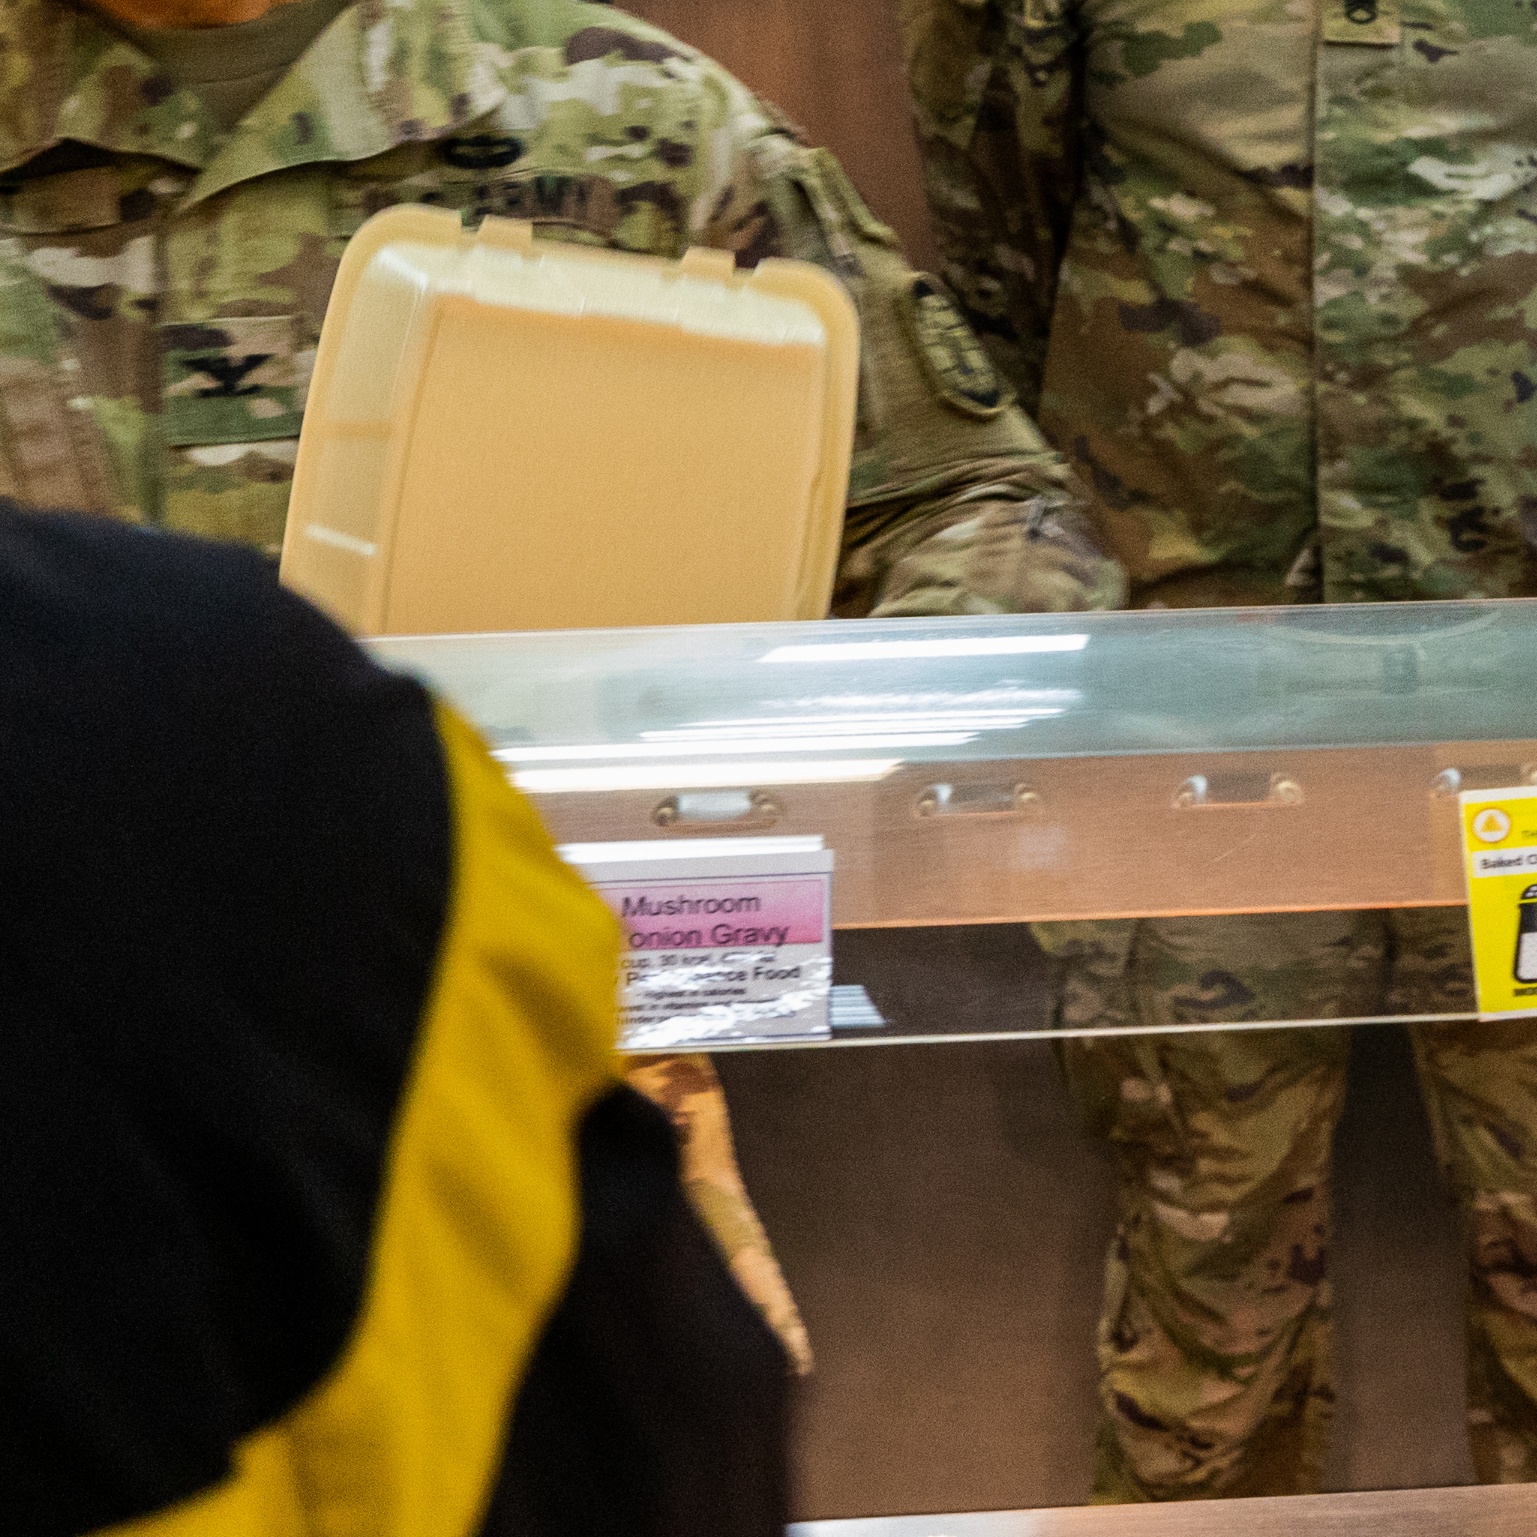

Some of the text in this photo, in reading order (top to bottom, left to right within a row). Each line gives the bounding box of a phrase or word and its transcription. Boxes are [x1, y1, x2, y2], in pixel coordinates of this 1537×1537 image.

[622, 895, 761, 916] Mushroom
[629, 923, 790, 948] onion Gravy
[753, 966, 800, 980] Food
